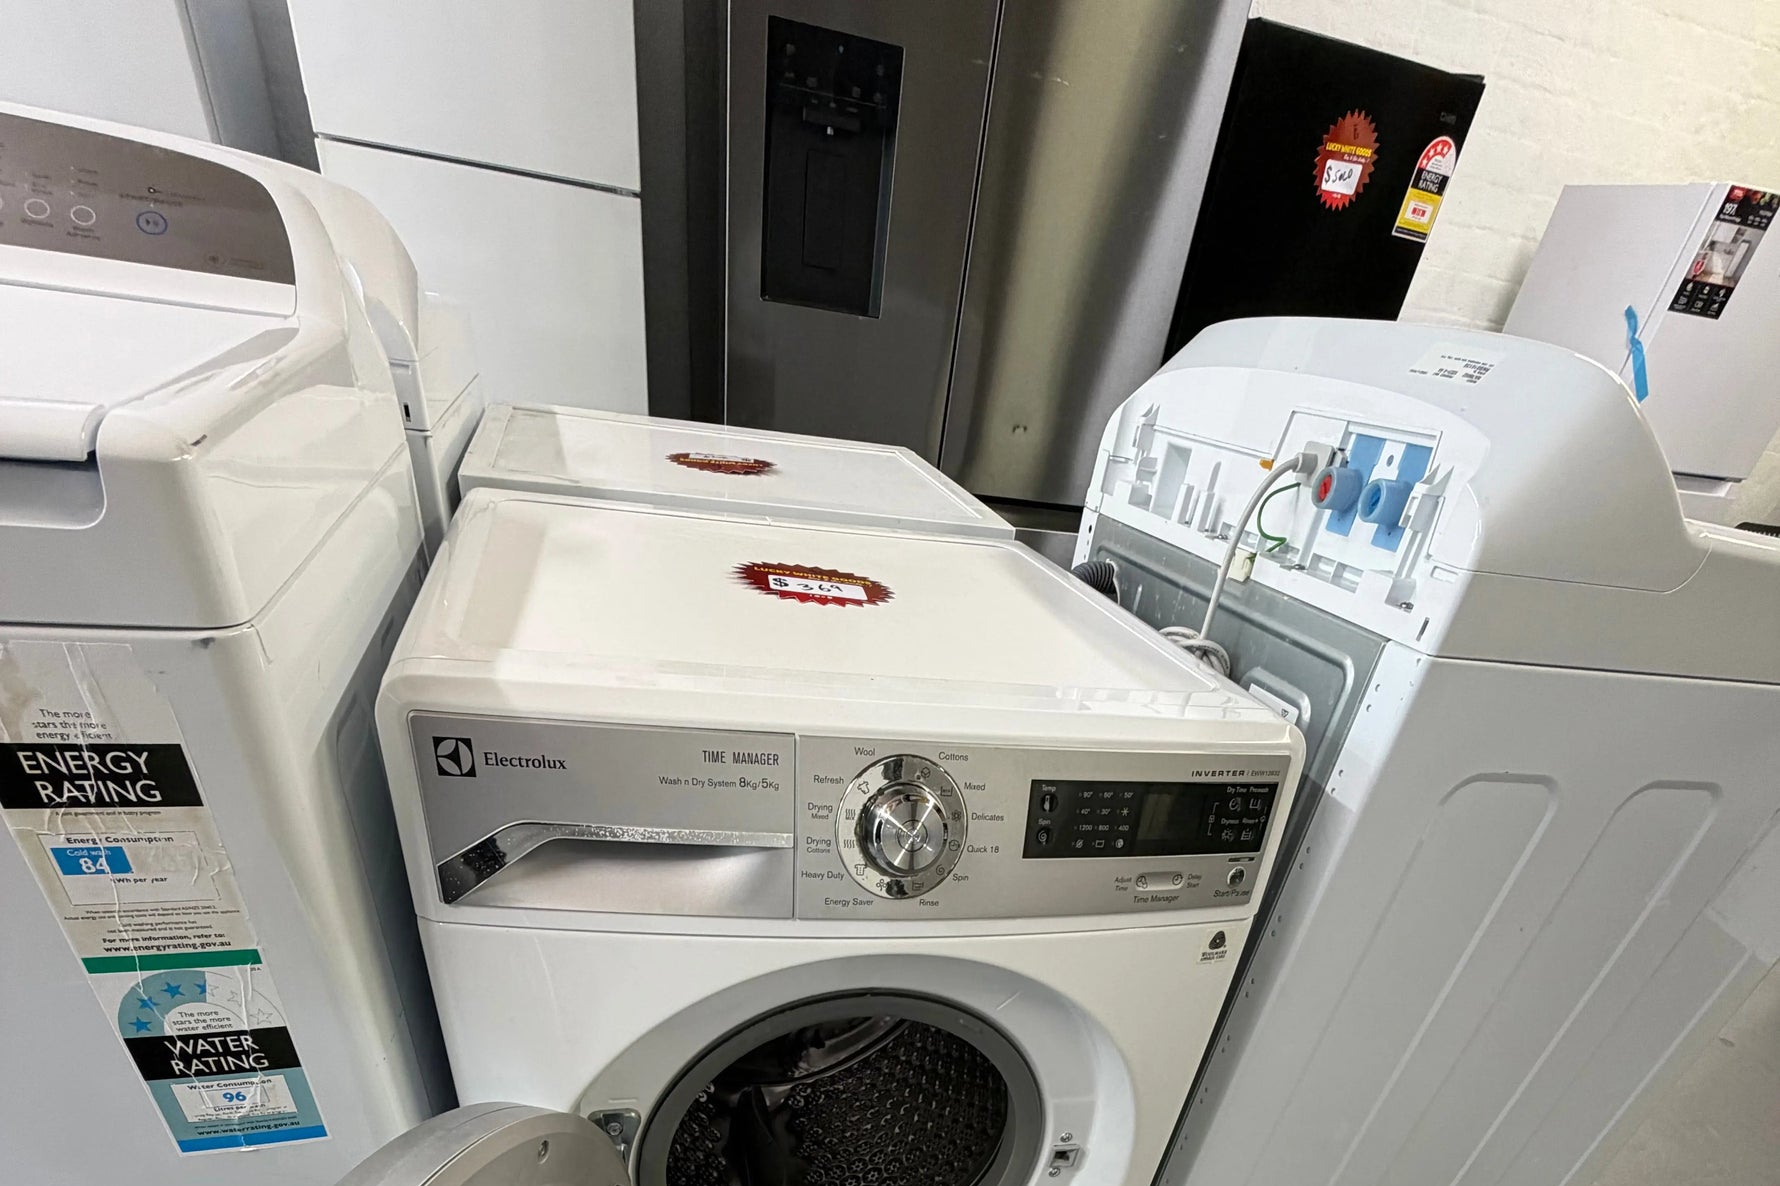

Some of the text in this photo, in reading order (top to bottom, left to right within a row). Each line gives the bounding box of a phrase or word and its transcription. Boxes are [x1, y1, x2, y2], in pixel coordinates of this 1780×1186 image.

[1421, 170, 1444, 182] ENERGY
[1418, 180, 1439, 193] RATING
[753, 566, 791, 576] LUCKY
[40, 708, 93, 719] The more
[32, 720, 107, 730] stars the more
[36, 731, 112, 741] energy eficient
[854, 747, 876, 757] Wool
[938, 751, 969, 762] Cottons
[483, 751, 568, 771] Electrolux
[702, 750, 780, 766] TIME MANAGER
[16, 751, 150, 776] ENERGY
[658, 776, 683, 785] Wash
[691, 777, 706, 788] Dry
[707, 778, 737, 789] System
[813, 775, 845, 785] Refresh
[963, 782, 986, 791] Mixed
[1042, 784, 1057, 793] Temp
[34, 780, 163, 804] RATING
[807, 802, 833, 813] Drying
[971, 812, 1004, 822] Delicates
[1038, 817, 1051, 826] Spin
[66, 837, 101, 846] Energ
[806, 837, 832, 848] Drying
[967, 845, 988, 854] Quick
[79, 857, 109, 874] 84
[801, 870, 845, 881] Heavy Duty
[952, 873, 969, 882] Spin
[1114, 876, 1132, 884] Adjust
[1187, 873, 1202, 881] Delay
[133, 877, 148, 886] per
[1186, 881, 1200, 889] Start
[824, 897, 874, 907] Energy Saver
[919, 898, 940, 907] Rinse
[1133, 893, 1181, 904] Time Manager
[141, 934, 192, 943] information,
[103, 940, 232, 953] www.energyrating.gov.au
[202, 1023, 234, 1031] efficient
[164, 1035, 260, 1057] WATER
[170, 1053, 270, 1076] RATING
[187, 1079, 272, 1091] Wter Consumpon
[223, 1091, 247, 1103] 96
[197, 1121, 300, 1136] www.waterrating.gov.au
